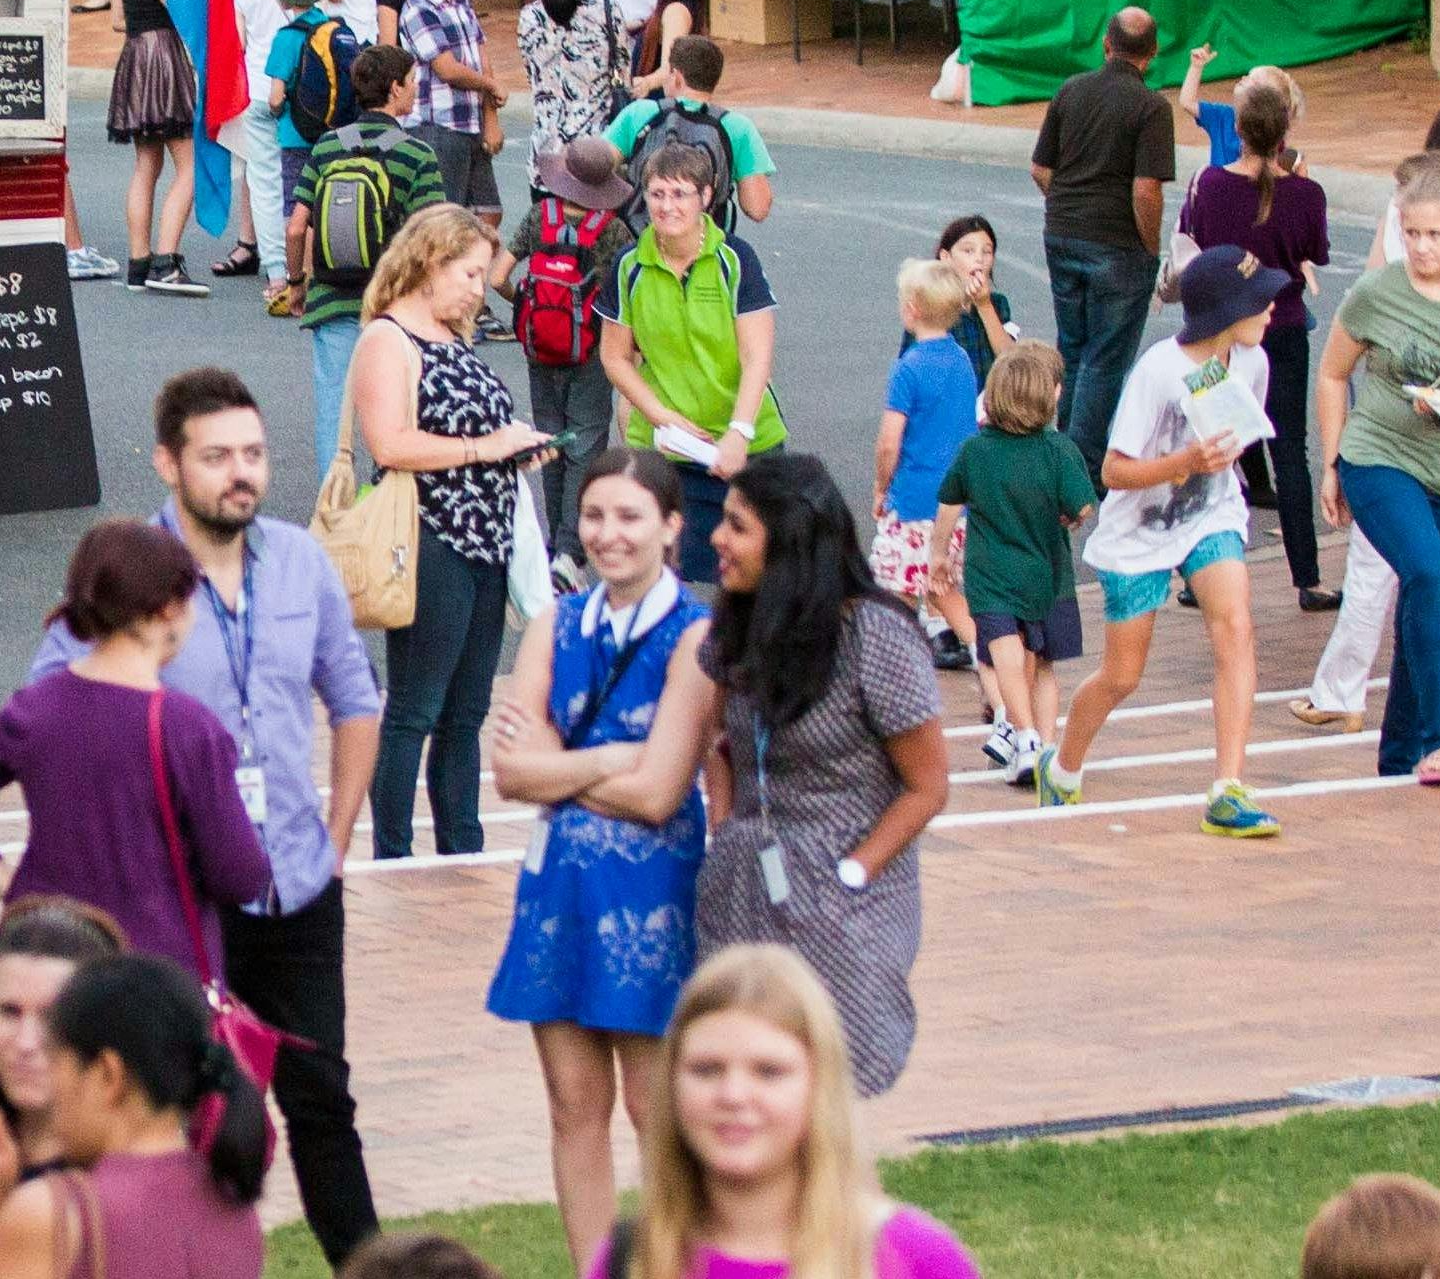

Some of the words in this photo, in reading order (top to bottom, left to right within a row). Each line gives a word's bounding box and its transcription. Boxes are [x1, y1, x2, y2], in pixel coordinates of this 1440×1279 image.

[34, 304, 57, 326] $8
[16, 332, 43, 350] $2
[22, 390, 51, 407] $10
